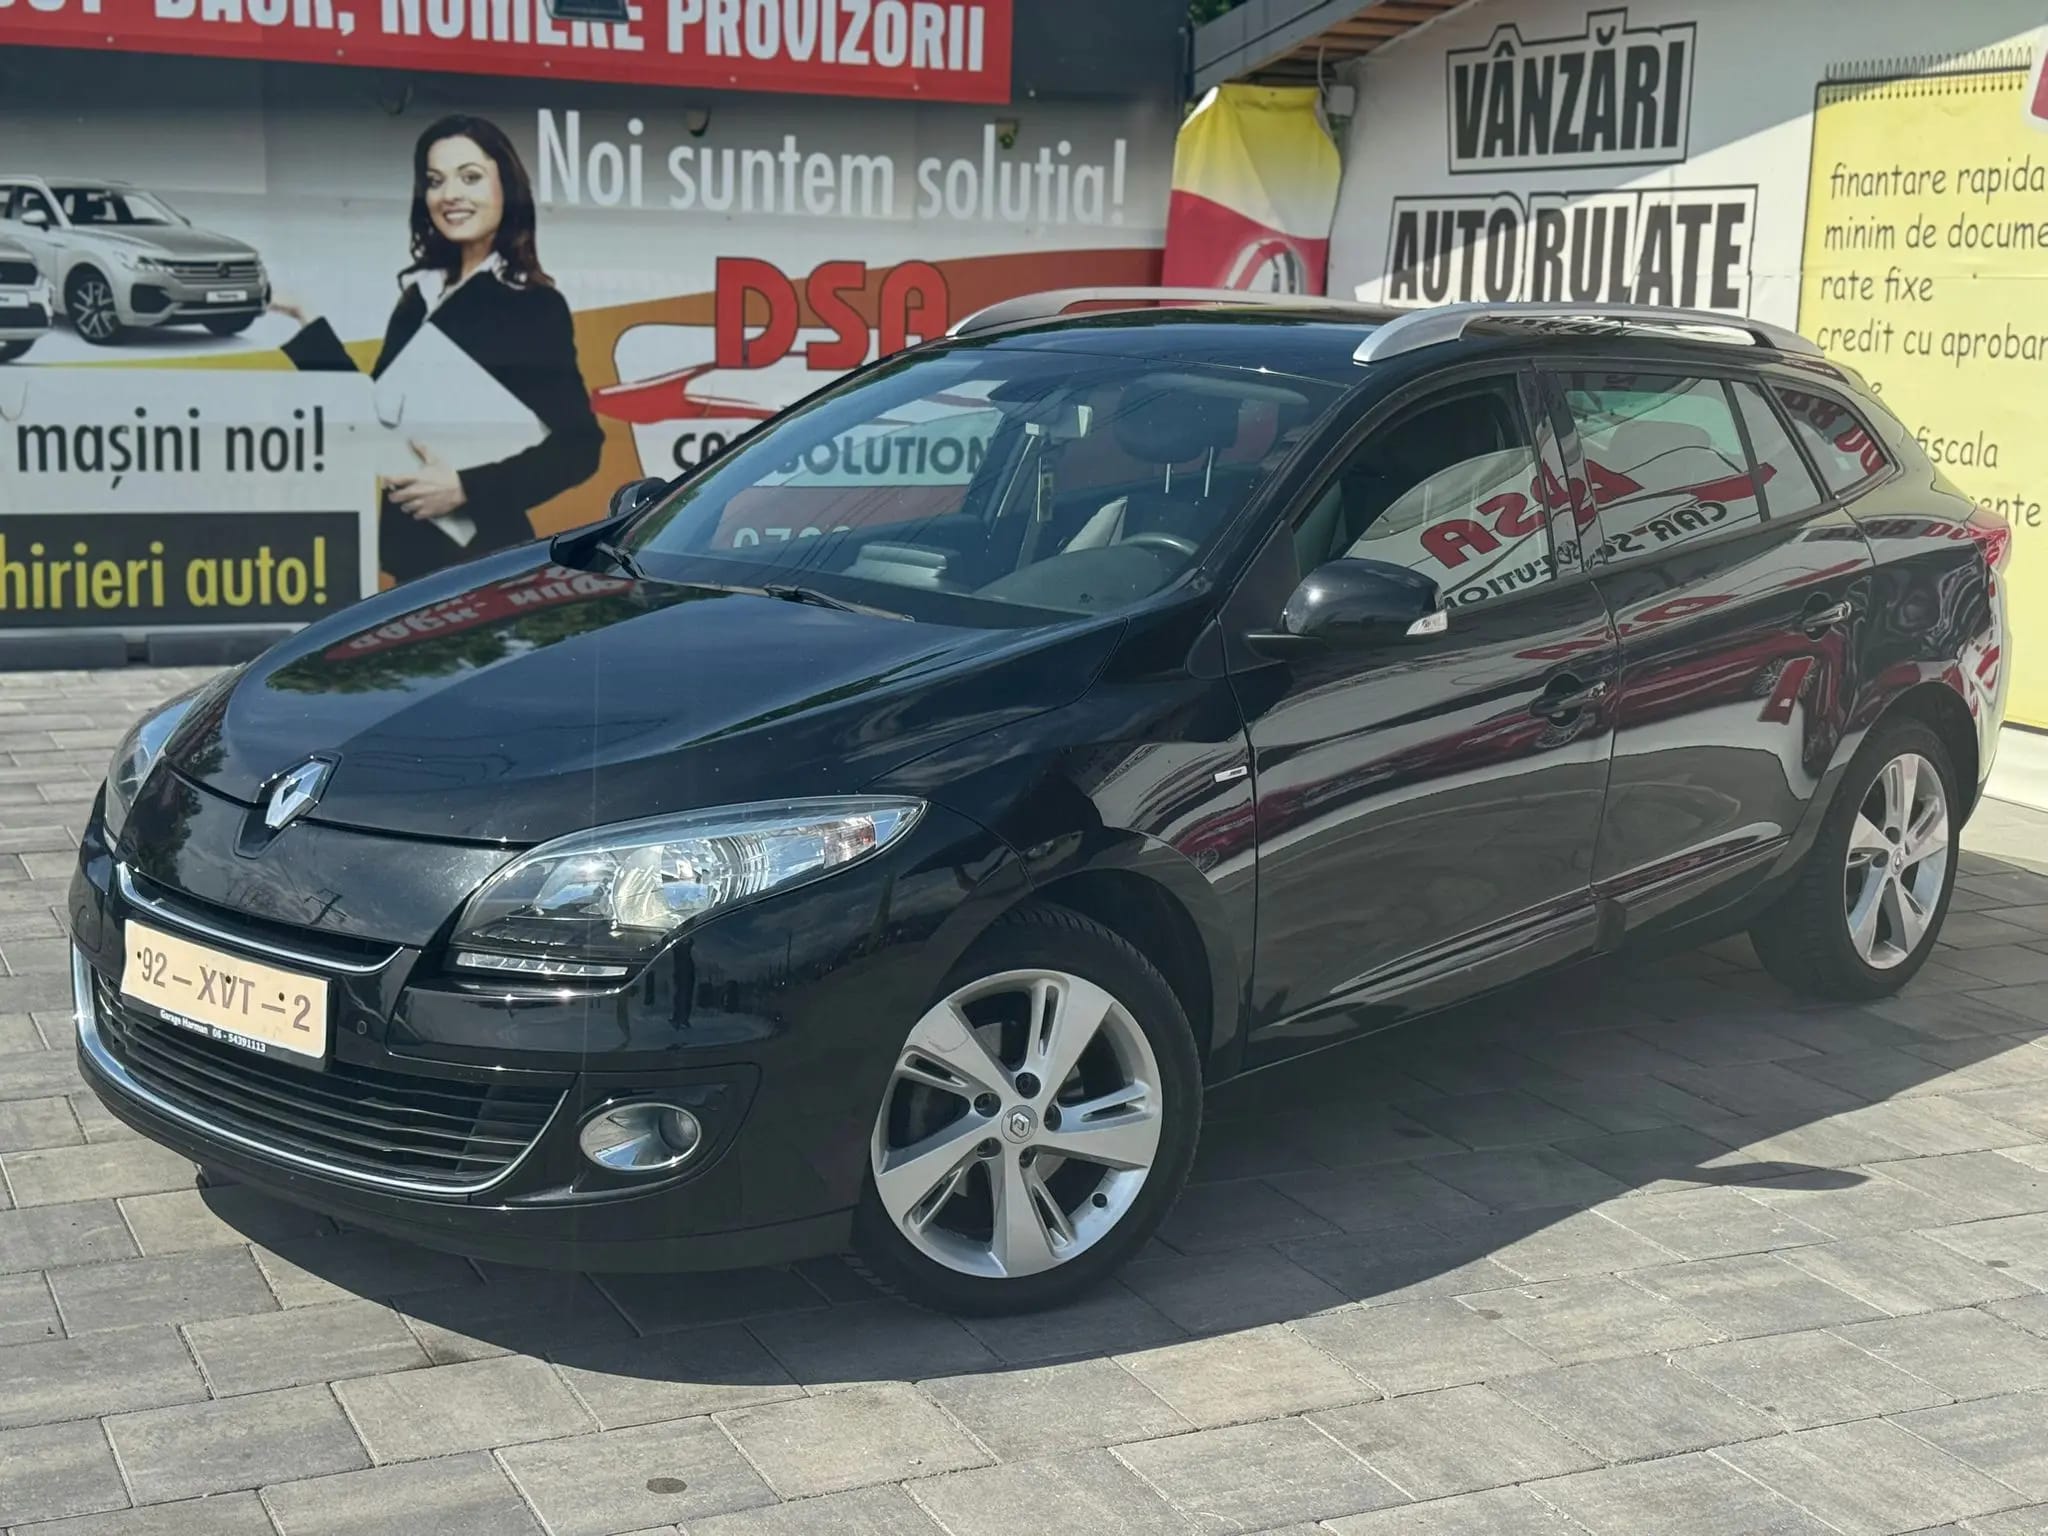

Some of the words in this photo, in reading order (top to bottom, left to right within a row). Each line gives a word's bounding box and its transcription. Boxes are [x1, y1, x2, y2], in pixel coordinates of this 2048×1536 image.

[667, 0, 984, 72] PROVIZORII
[1455, 27, 1685, 159] VÂNZĂRI
[537, 108, 644, 206] Noi
[667, 134, 894, 216] suntem
[1830, 162, 1947, 198] finantare
[1956, 155, 2045, 204] rapida
[1389, 208, 1525, 302] AUTO
[1528, 202, 1746, 310] RULATE
[1824, 215, 1896, 250] minim
[1905, 212, 1937, 248] de
[1947, 211, 2048, 248] docume
[716, 256, 949, 370] DSA
[1820, 270, 1874, 301] rate
[1884, 266, 1934, 303] fixe
[1816, 319, 1894, 354] credit
[1903, 332, 1932, 355] cu
[17, 406, 200, 489] mașini
[226, 405, 325, 473] noi!
[186, 536, 327, 607] auto!
